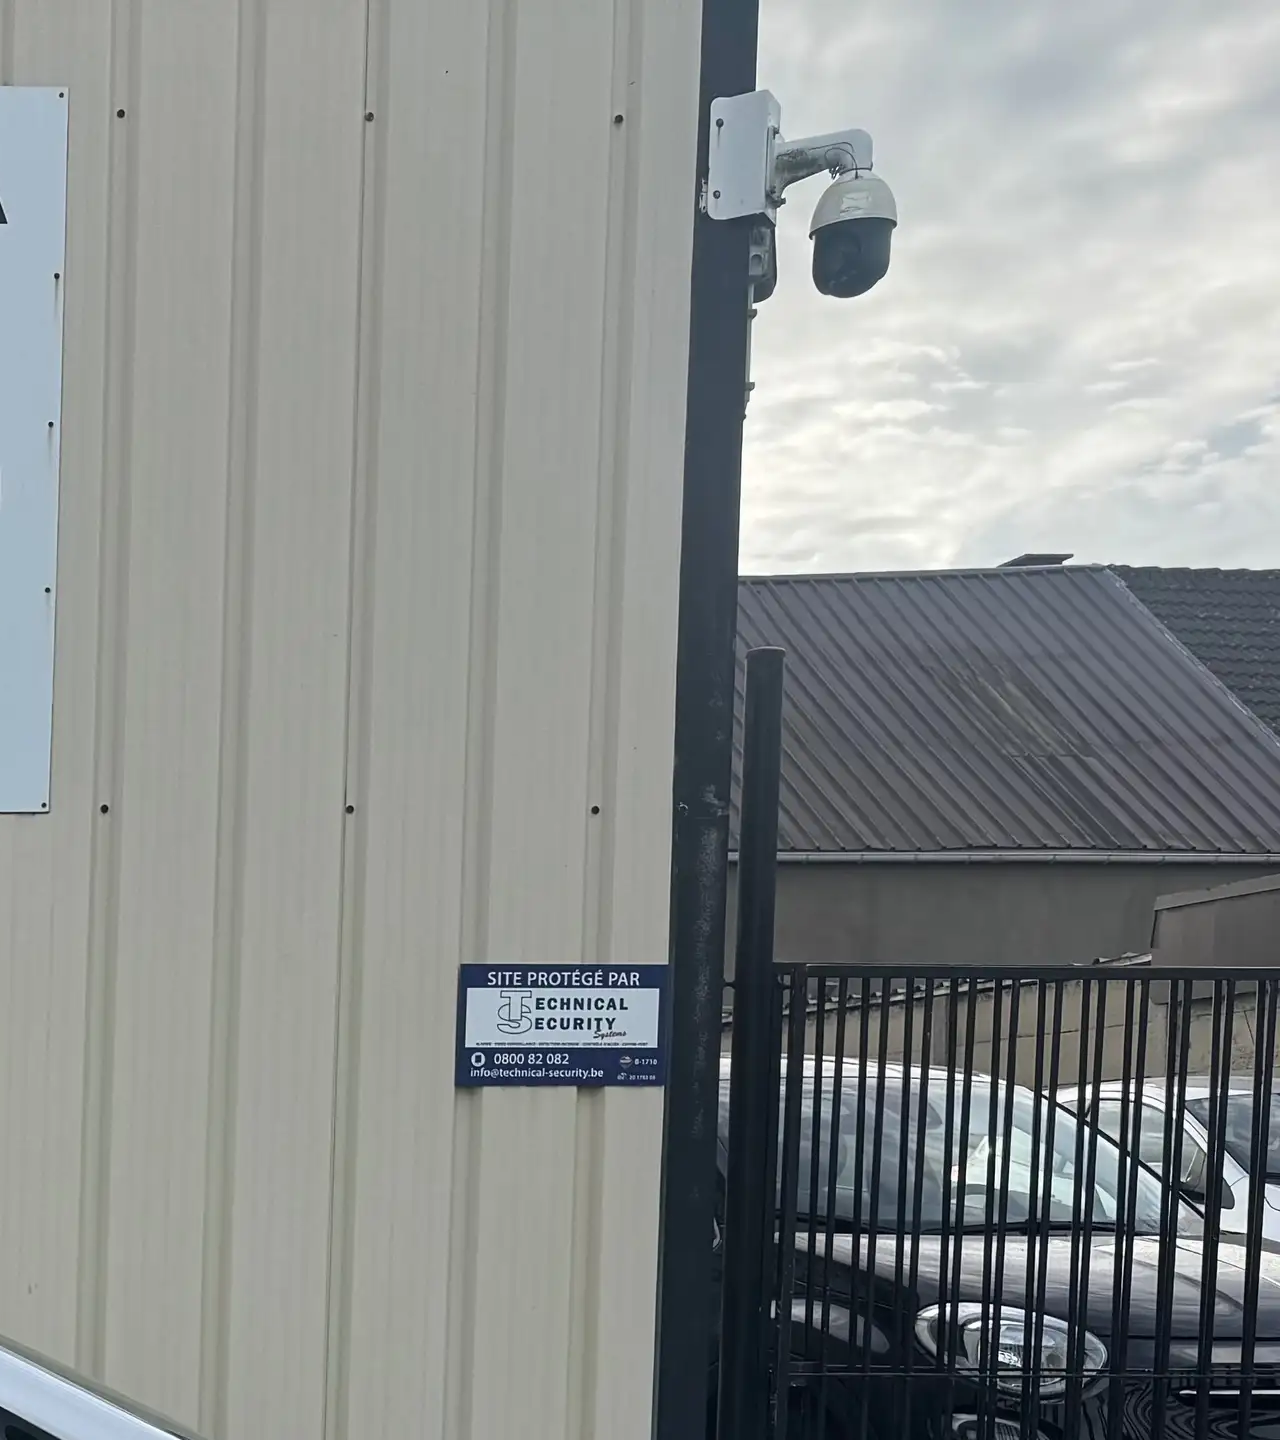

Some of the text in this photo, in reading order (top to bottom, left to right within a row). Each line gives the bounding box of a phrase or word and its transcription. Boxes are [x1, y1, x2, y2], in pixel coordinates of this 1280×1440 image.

[487, 969, 640, 986] SITE PROTÉGÉ PAR
[593, 1030, 627, 1041] Systems
[493, 1053, 570, 1065] 0800 82 082
[470, 1067, 604, 1079] info@technical-security.be
